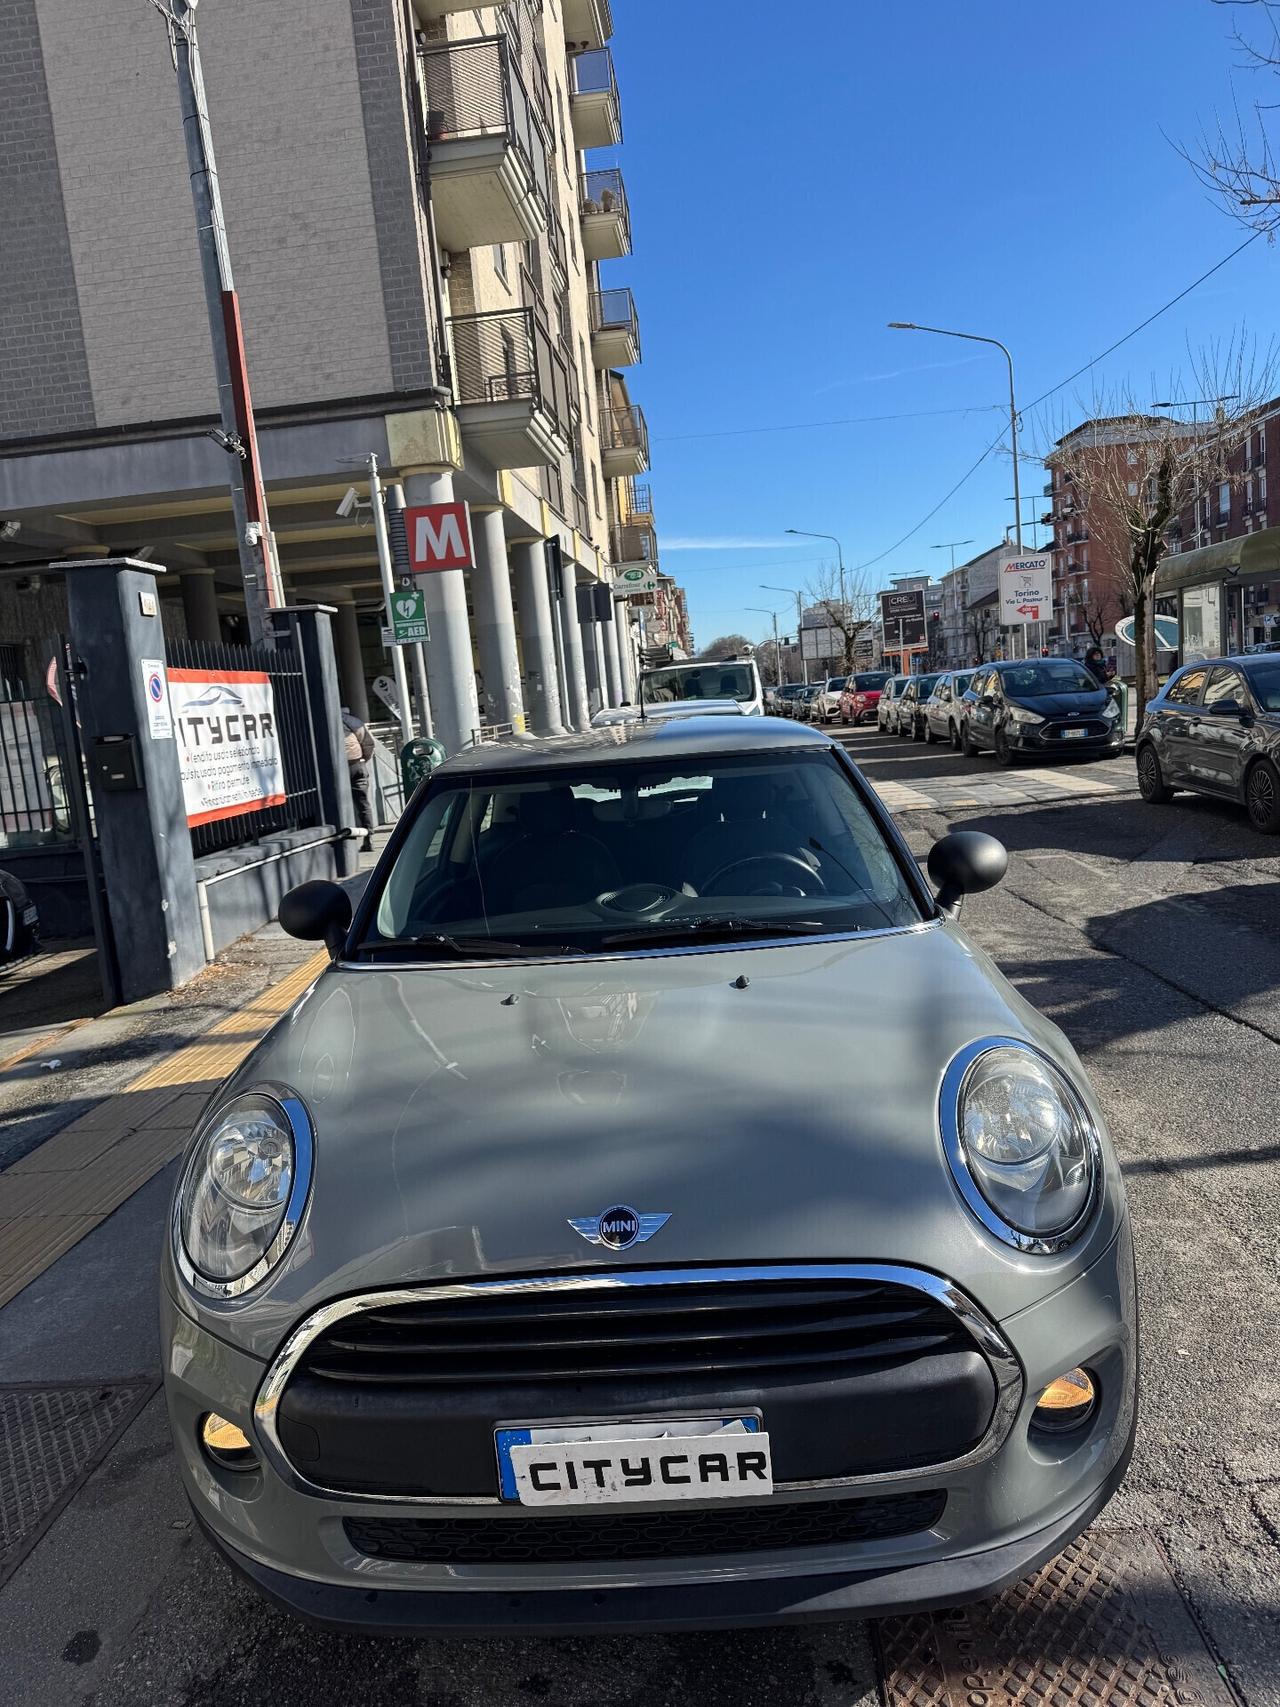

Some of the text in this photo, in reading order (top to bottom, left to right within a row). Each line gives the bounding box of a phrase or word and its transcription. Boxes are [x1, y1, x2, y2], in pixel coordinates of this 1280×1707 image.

[415, 514, 466, 562] M
[1004, 560, 1045, 572] MERCATO
[1014, 589, 1039, 597] Torino
[408, 627, 426, 636] AED
[173, 713, 274, 747] ITYCAR
[603, 1220, 635, 1232] MINI
[529, 1451, 768, 1491] CITYCAR
